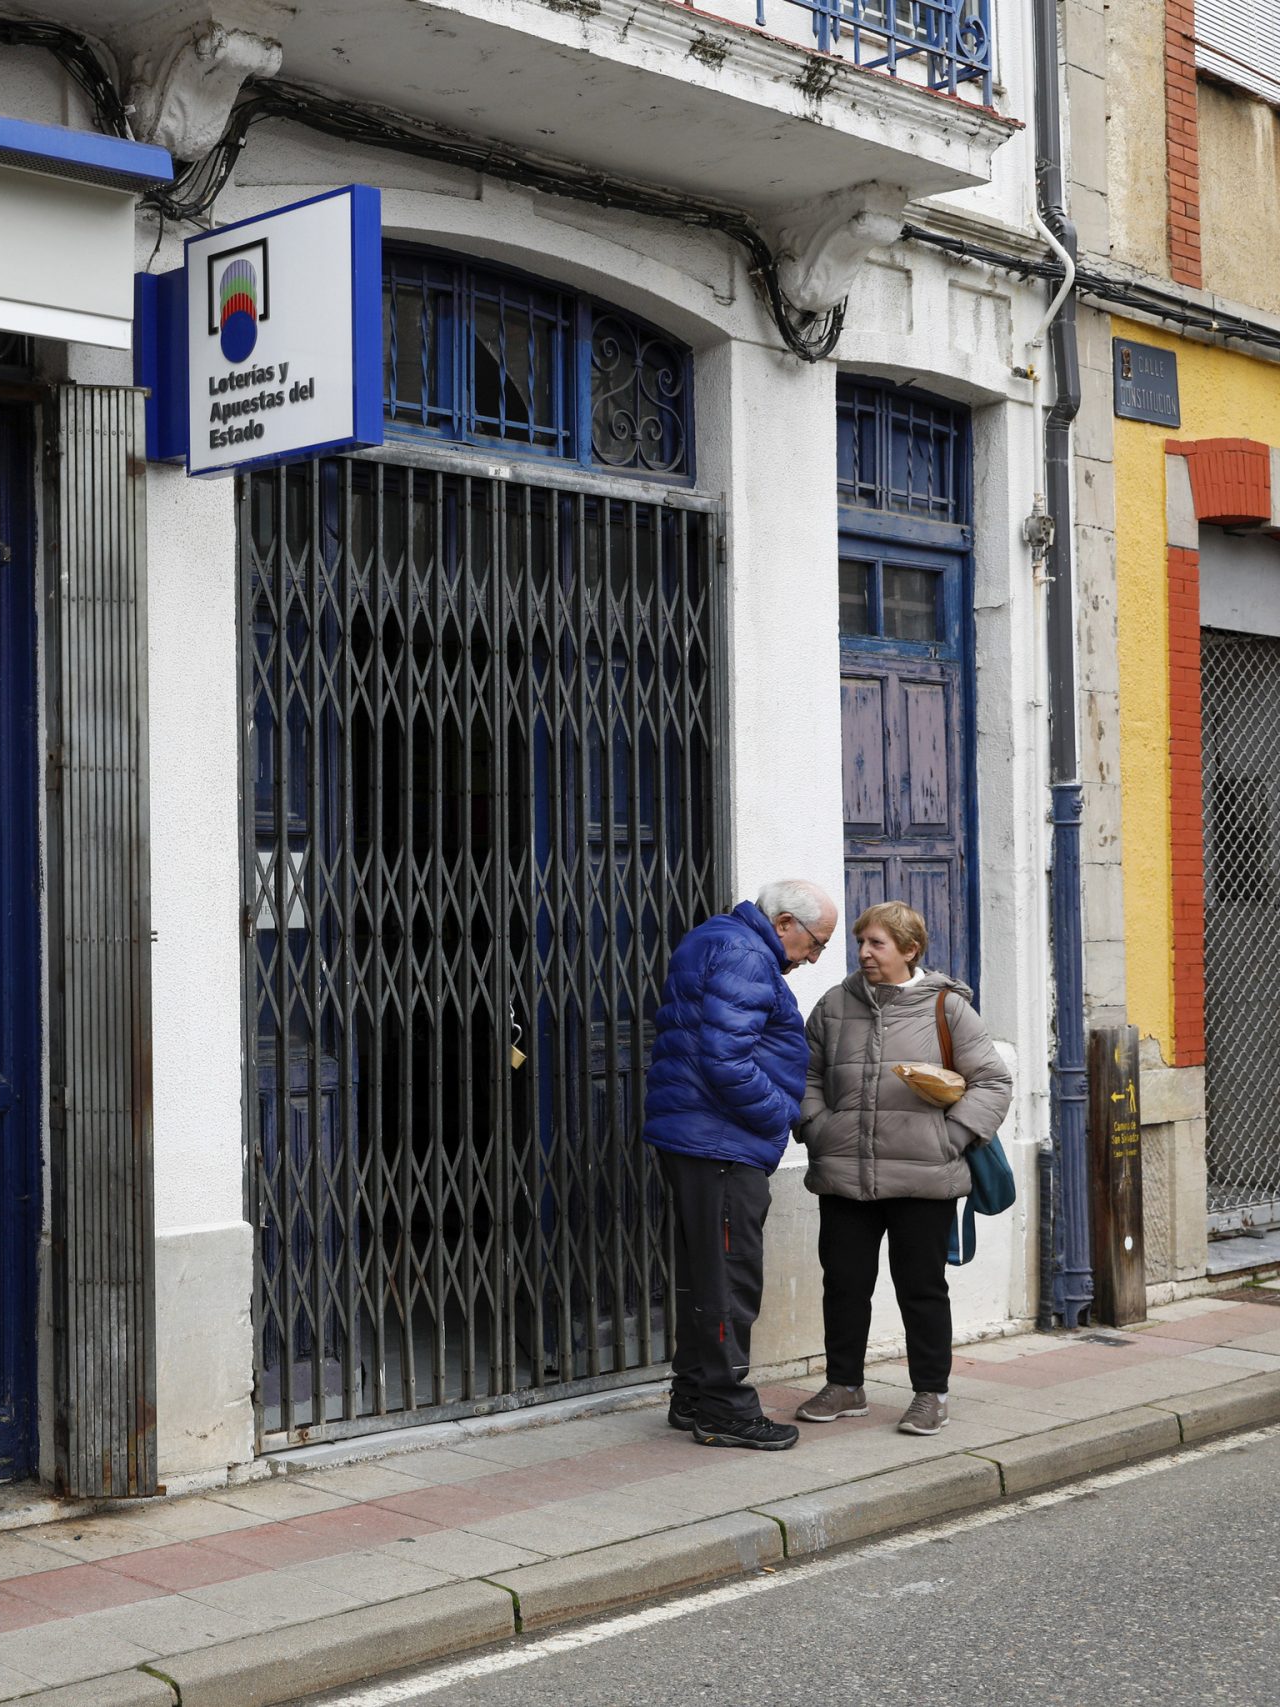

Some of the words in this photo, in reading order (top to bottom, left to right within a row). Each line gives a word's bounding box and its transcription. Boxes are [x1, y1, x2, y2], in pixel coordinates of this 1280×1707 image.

[208, 364, 275, 396] Loterías
[278, 362, 289, 384] y
[1138, 355, 1164, 378] CALLE
[209, 390, 285, 425] Apuestas
[289, 377, 315, 403] del
[209, 419, 264, 450] Estado
